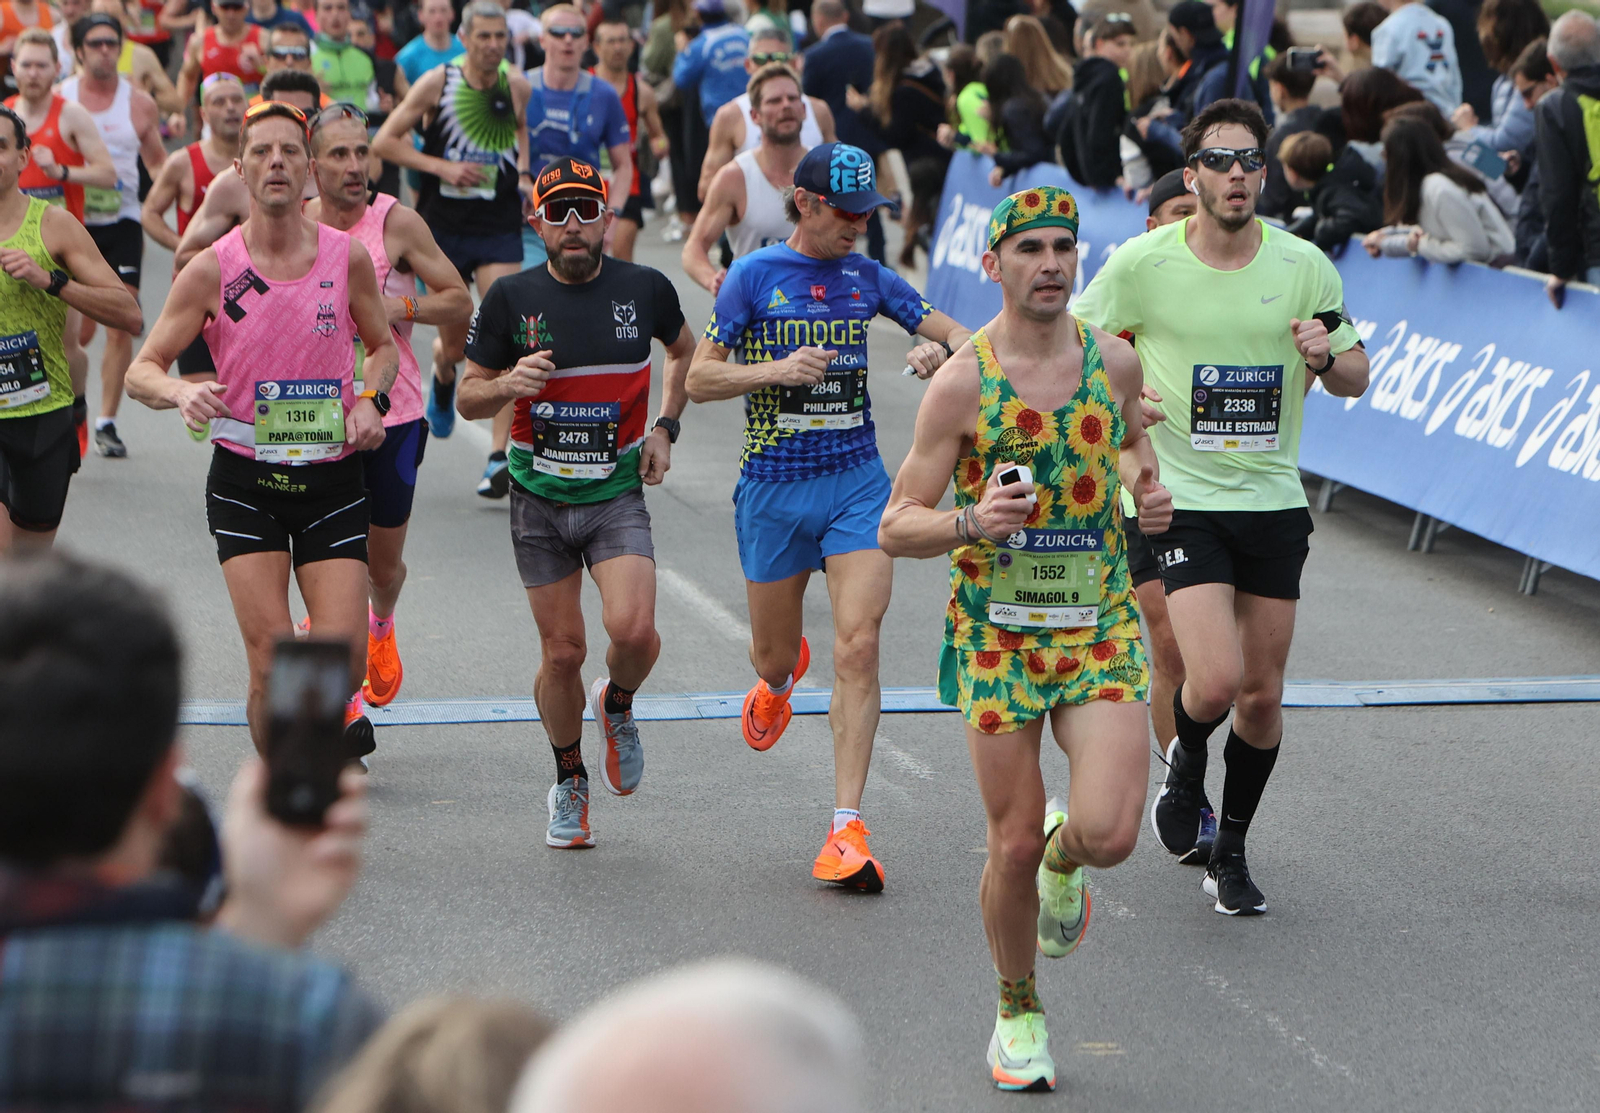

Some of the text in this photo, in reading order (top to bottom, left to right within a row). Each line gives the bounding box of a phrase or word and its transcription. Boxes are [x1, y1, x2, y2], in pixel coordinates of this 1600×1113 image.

[542, 168, 560, 184] OTSO
[520, 320, 546, 332] RUN
[616, 326, 638, 339] OTSO
[0, 336, 28, 352] RICH
[513, 332, 554, 344] KENYA
[831, 354, 858, 366] RICH
[0, 362, 14, 375] 54
[1226, 371, 1275, 382] ZURICH
[1370, 332, 1463, 421] asics
[286, 385, 332, 395] ZURICH
[811, 381, 841, 394] 2846
[804, 402, 848, 412] PHILIPPE
[1224, 398, 1256, 412] 2338
[1454, 357, 1554, 448] asics
[286, 410, 315, 422] 1316
[560, 407, 609, 417] ZURICH
[1197, 421, 1276, 433] GUILLE ESTRADA
[268, 429, 333, 442] PAPA@TOÑIN
[558, 432, 589, 444] 2478
[1016, 441, 1039, 450] POWER
[542, 447, 609, 462] JUANITASTYLE
[257, 478, 306, 492] HANKER
[1034, 534, 1092, 546] ZURICH
[1032, 565, 1065, 580] 1552
[1014, 590, 1079, 603] SIMAGOL 9
